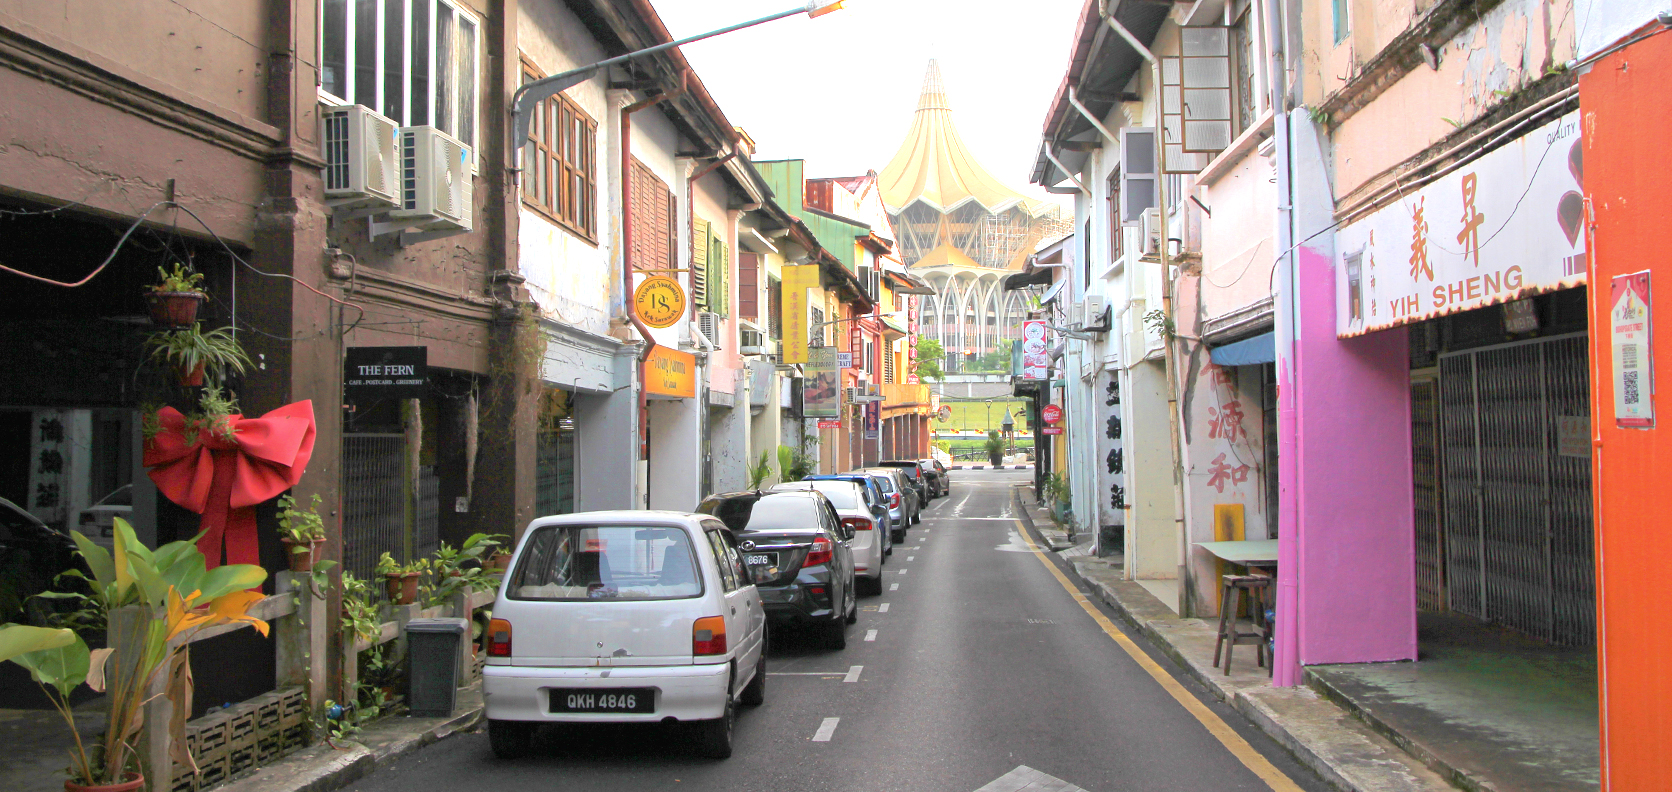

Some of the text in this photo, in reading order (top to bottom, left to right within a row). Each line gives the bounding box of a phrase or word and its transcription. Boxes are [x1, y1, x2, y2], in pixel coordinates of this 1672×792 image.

[1547, 122, 1575, 145] QUALITY
[638, 283, 656, 303] Dayang
[1390, 293, 1419, 318] YIH
[1433, 265, 1523, 308] SHENG
[358, 365, 414, 376] THE FERN
[567, 694, 636, 708] QKH 4846
